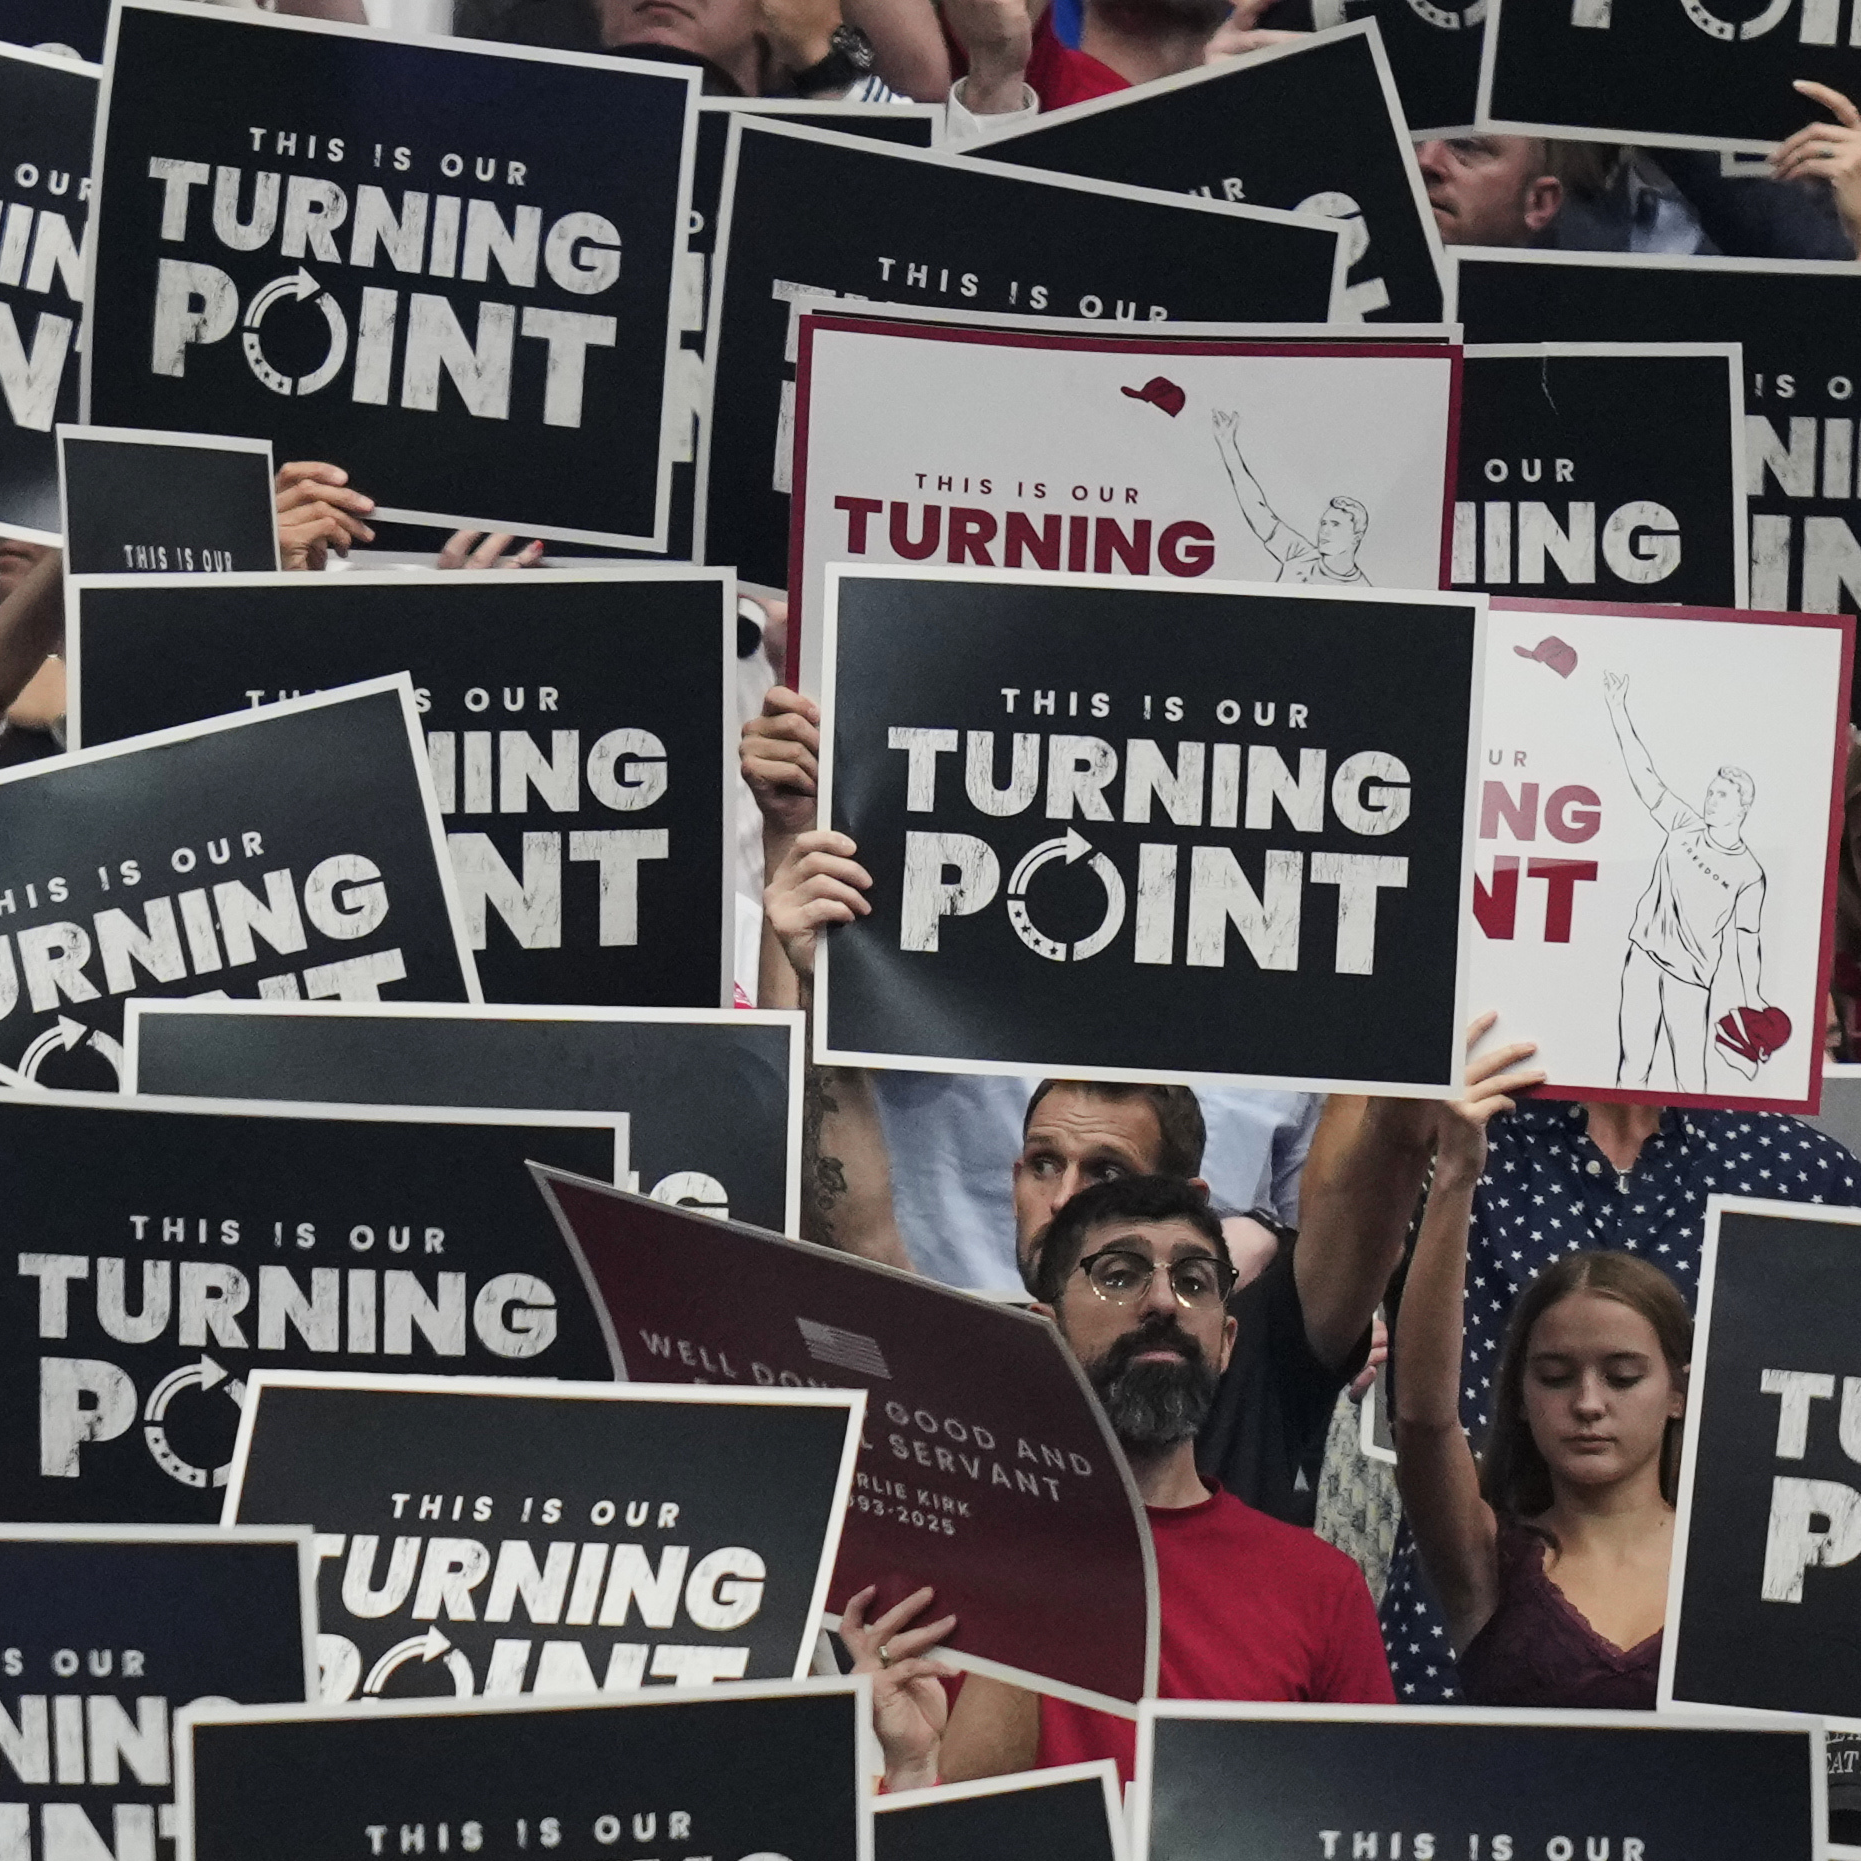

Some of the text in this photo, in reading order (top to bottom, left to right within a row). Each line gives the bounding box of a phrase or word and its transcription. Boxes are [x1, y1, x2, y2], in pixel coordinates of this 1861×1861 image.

[250, 127, 526, 185] THIS IS OUR
[149, 154, 621, 303] TURNING
[153, 258, 620, 428] POINT
[915, 473, 1138, 504] THIS IS OUR
[124, 545, 233, 572] THIS IS OUR
[834, 496, 1214, 577] TURNING
[1001, 688, 1308, 728] THIS IS OUR
[888, 727, 1411, 835] TURNING
[98, 860, 141, 890] IS
[172, 832, 264, 872] OUR
[900, 827, 1408, 975] POINT
[130, 1216, 444, 1253] THIS IS OUR
[19, 1253, 557, 1358] TURNING
[885, 1401, 1092, 1476] GOOD AND
[888, 1434, 1065, 1506] SERVANT
[366, 1811, 691, 1855] THIS IS OUR
[1319, 1830, 1434, 1861] THIS
